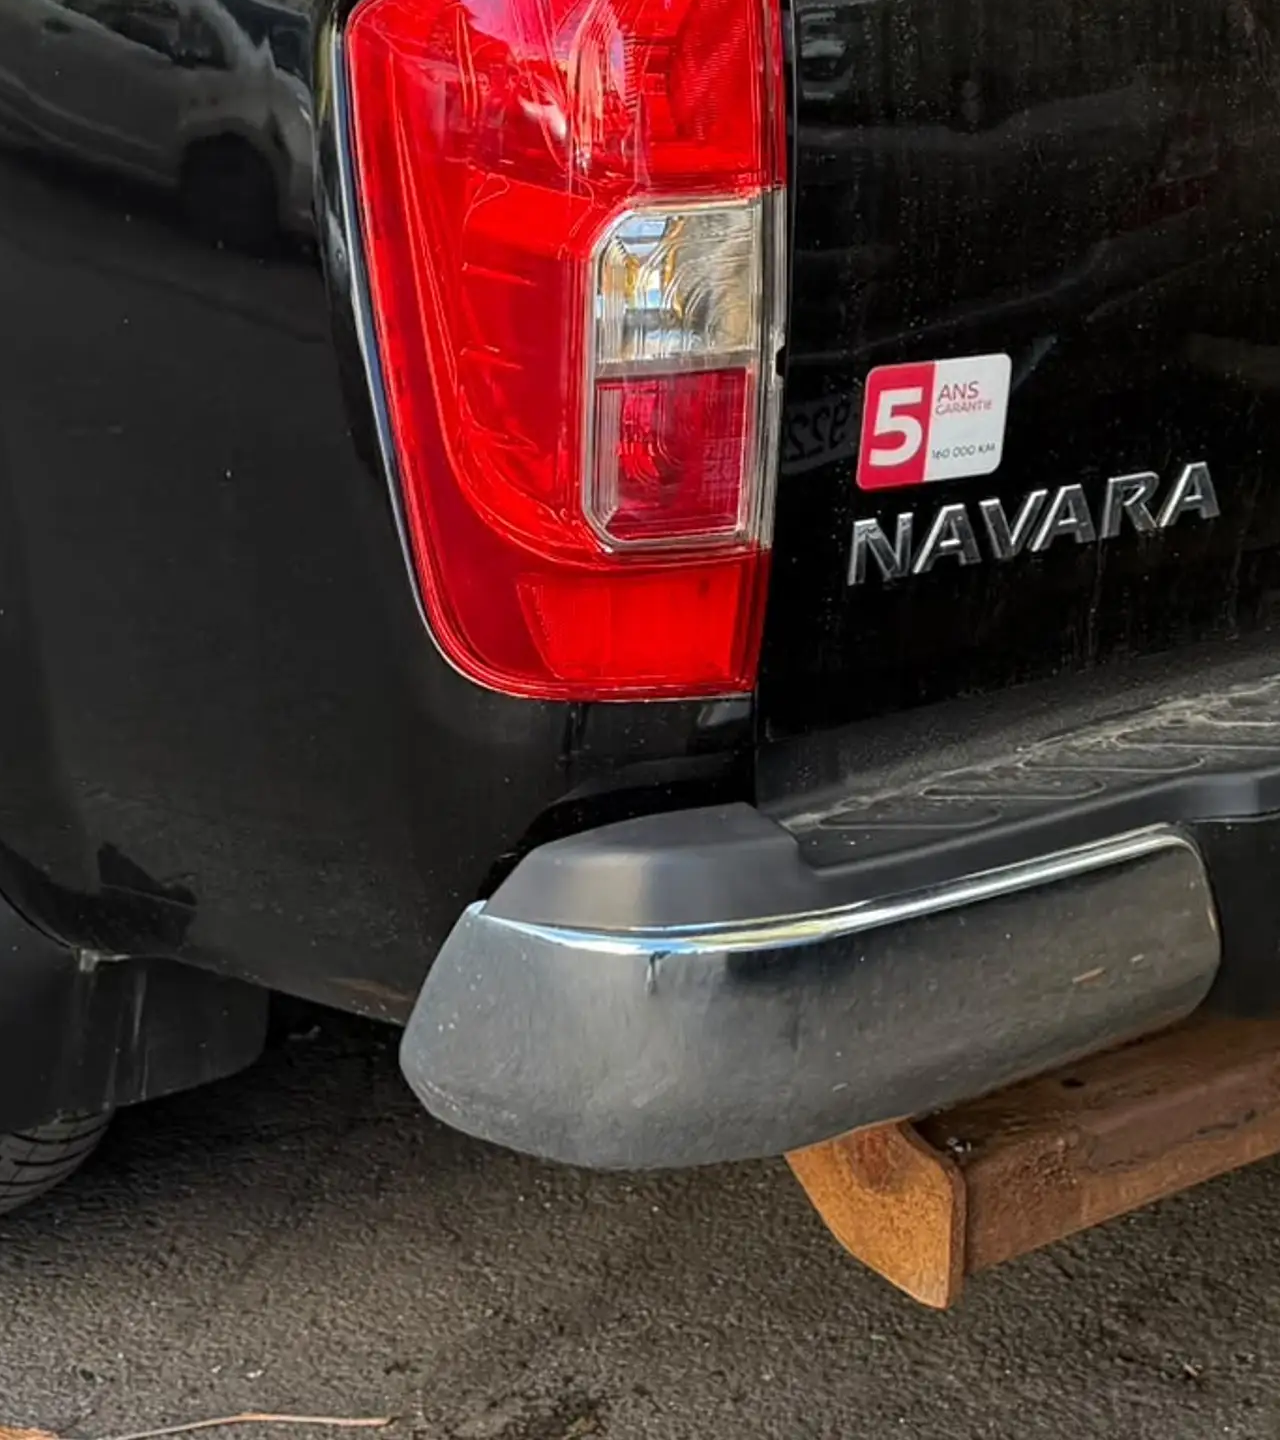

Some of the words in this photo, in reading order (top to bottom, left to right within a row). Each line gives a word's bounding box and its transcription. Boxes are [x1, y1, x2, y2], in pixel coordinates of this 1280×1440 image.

[937, 381, 979, 402] ANS
[935, 400, 992, 416] GARANTIE
[868, 386, 924, 467] 5
[952, 444, 977, 458] 000
[847, 461, 1220, 586] NAVARA
